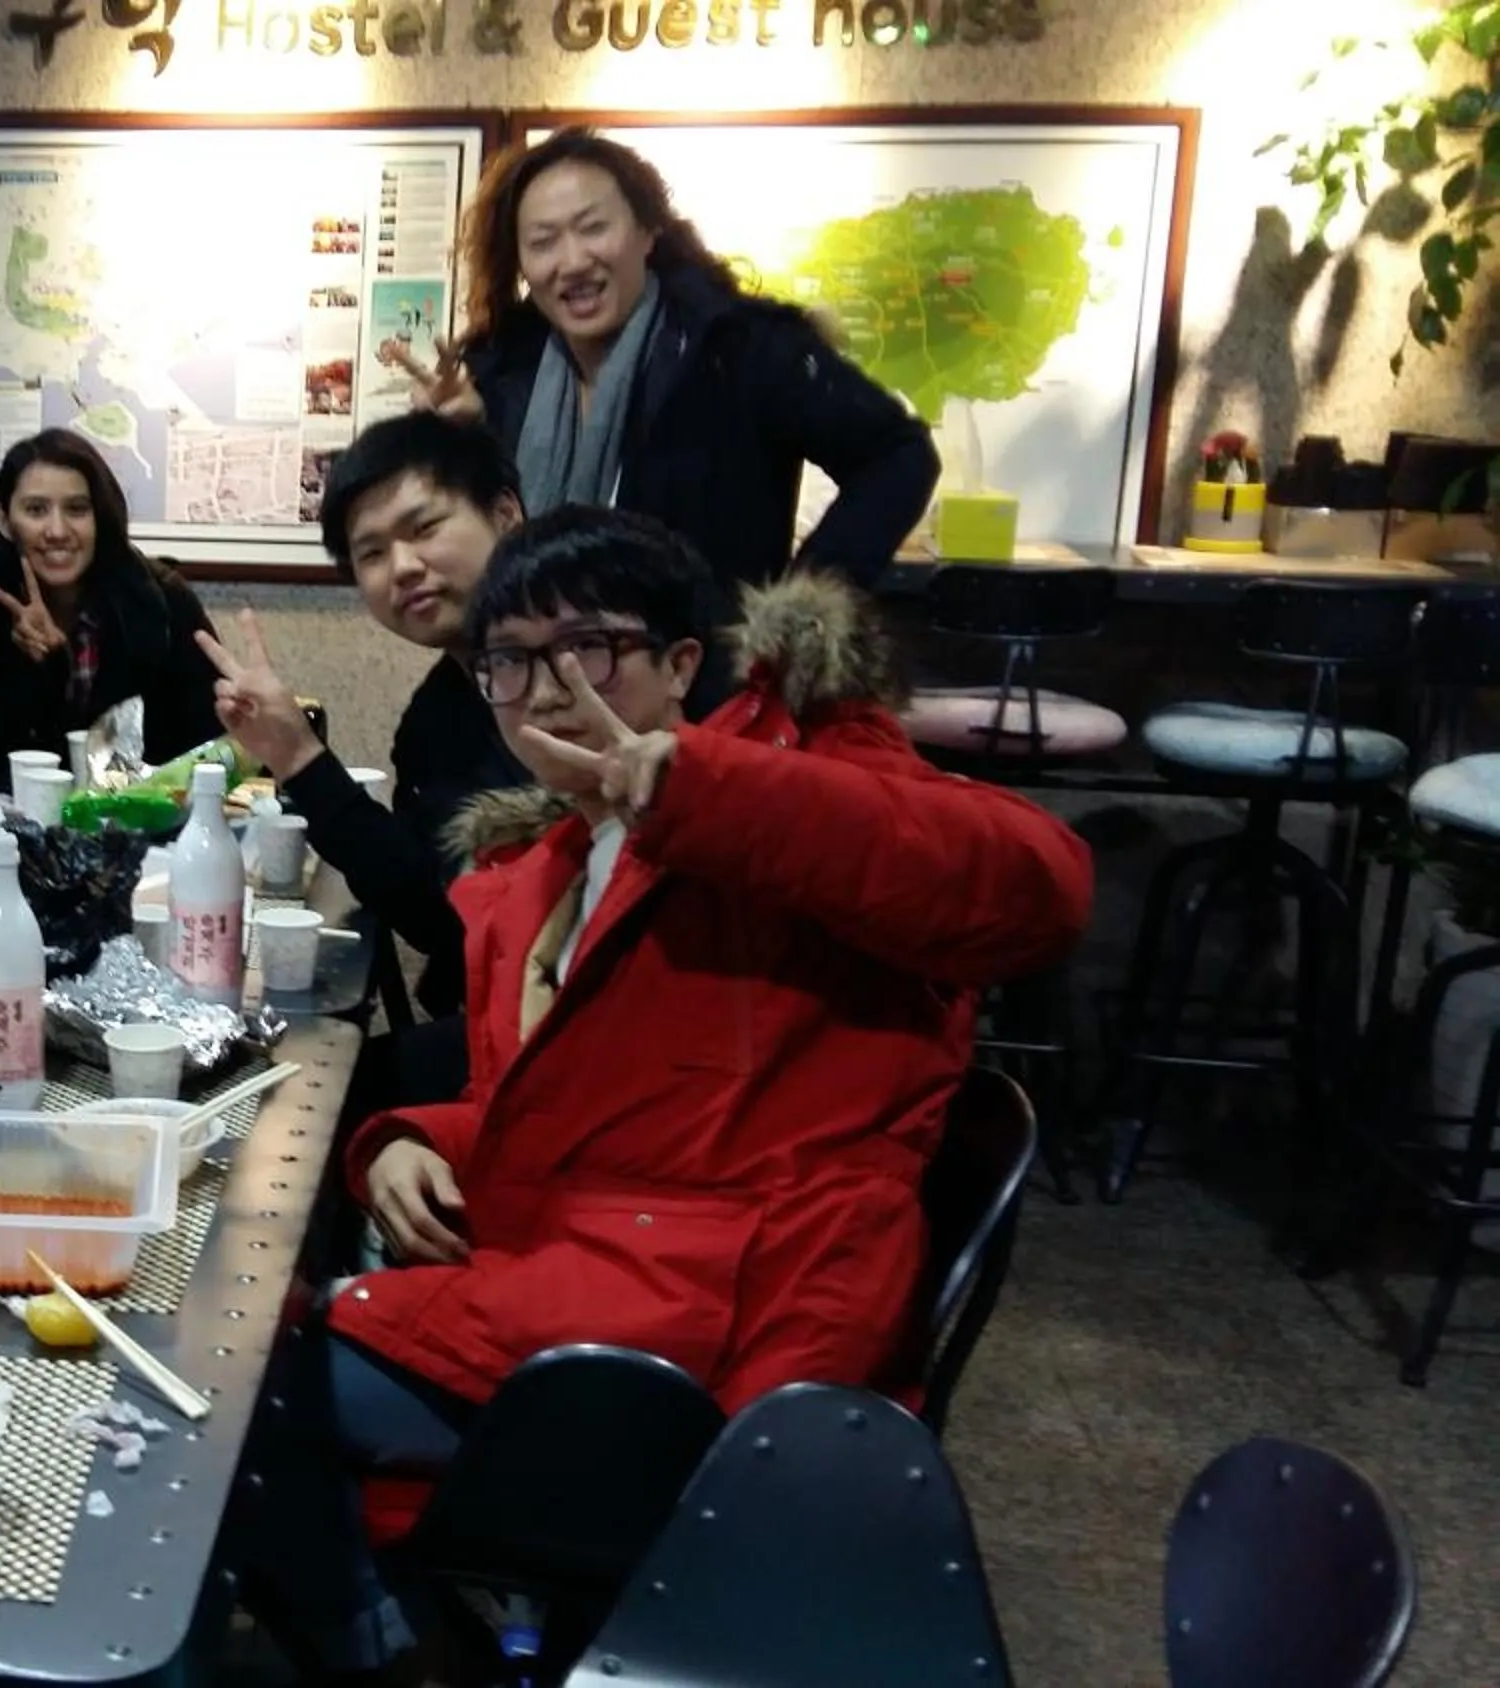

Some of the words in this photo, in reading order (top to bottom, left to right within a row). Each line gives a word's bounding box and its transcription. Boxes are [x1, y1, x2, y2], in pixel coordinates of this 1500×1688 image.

[215, 0, 446, 56] Hostel
[472, 0, 523, 55] &
[552, 0, 782, 52] Guest
